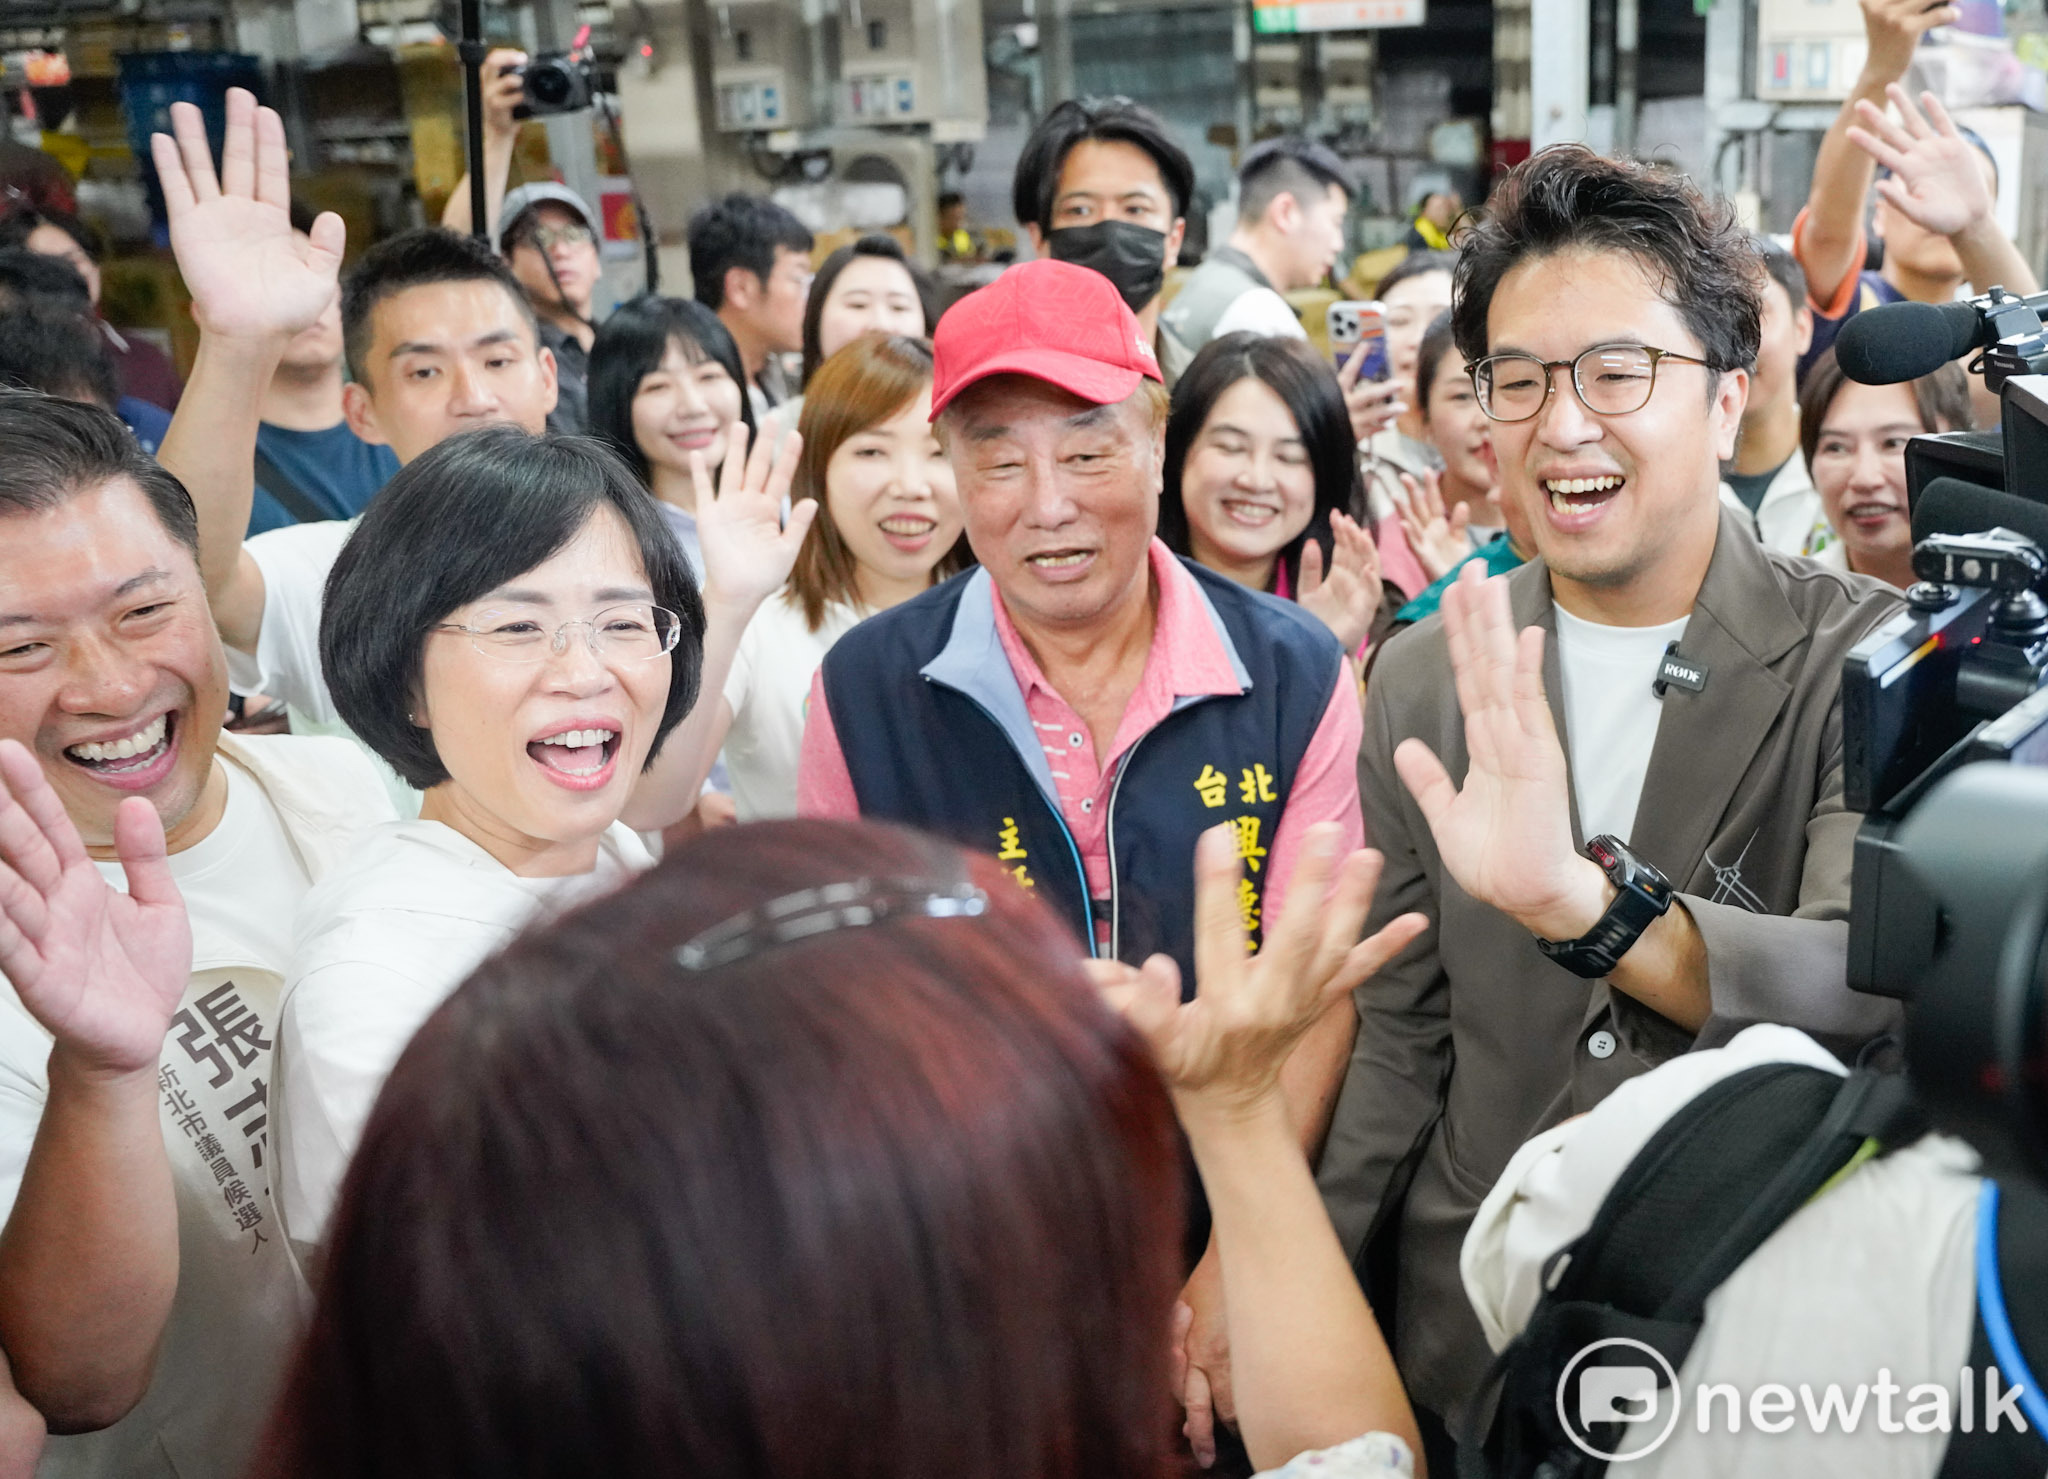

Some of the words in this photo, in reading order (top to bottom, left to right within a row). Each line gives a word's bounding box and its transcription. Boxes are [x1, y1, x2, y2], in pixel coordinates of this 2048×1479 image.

[1193, 763, 1277, 808] 台北
[158, 1063, 269, 1255] 新北市議員候選人
